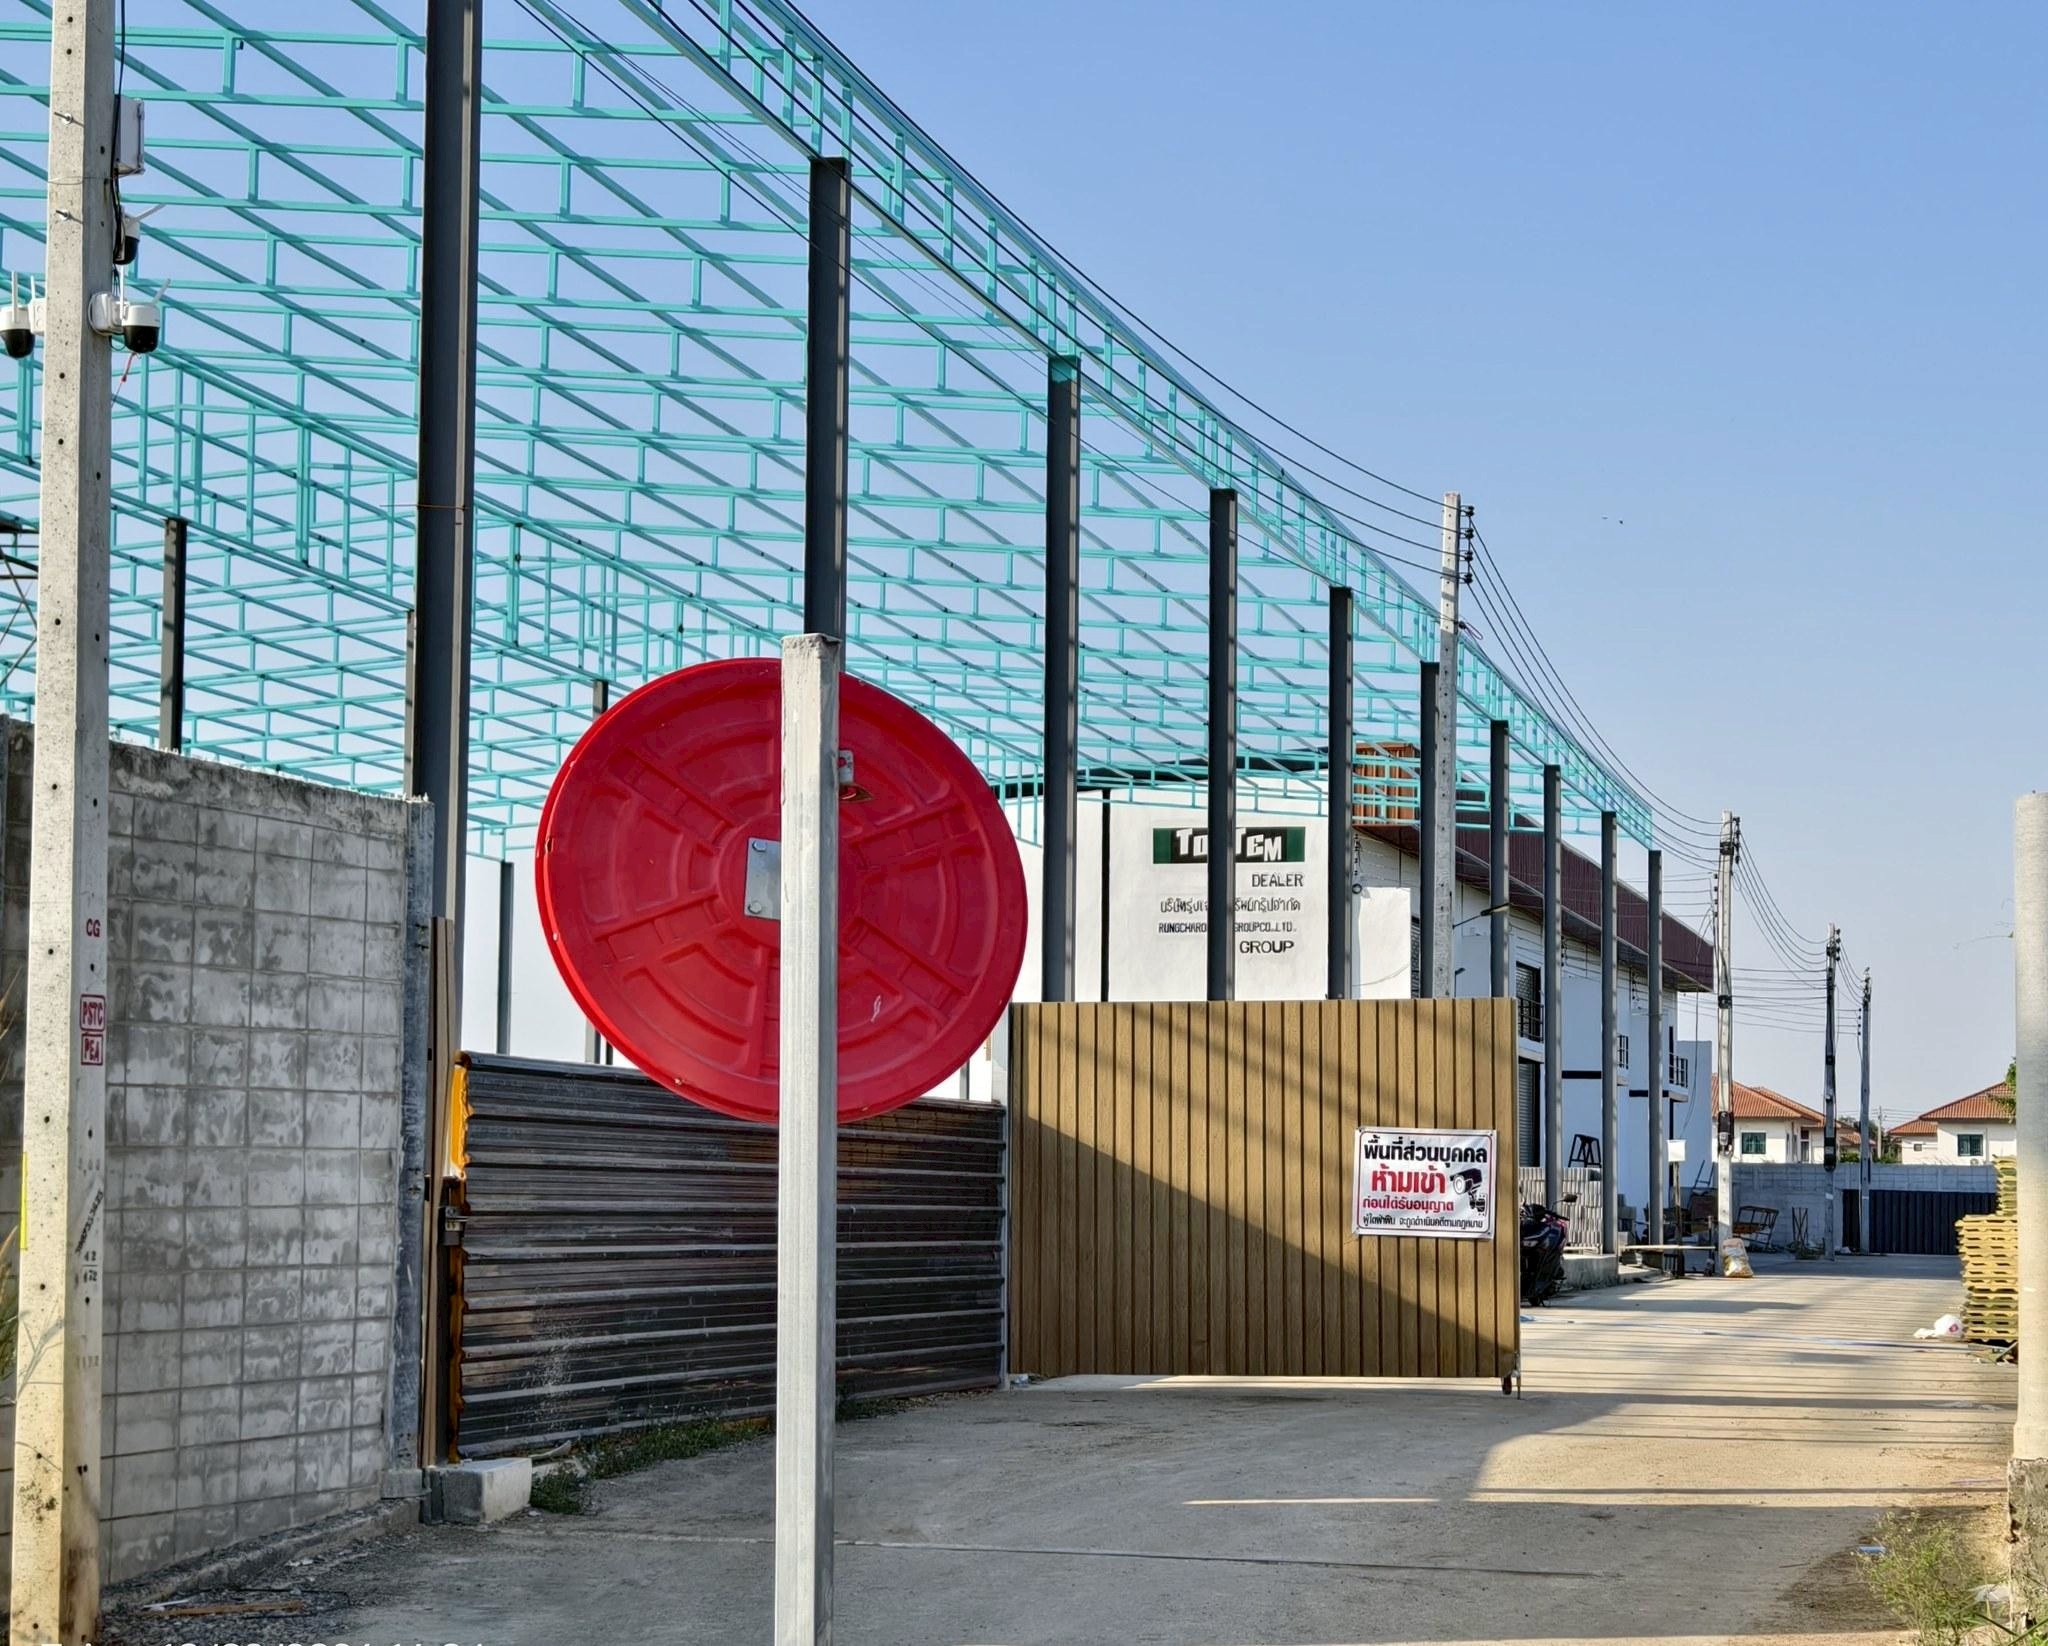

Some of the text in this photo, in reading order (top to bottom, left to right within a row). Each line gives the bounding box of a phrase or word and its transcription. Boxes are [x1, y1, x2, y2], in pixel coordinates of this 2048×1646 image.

[1176, 828, 1282, 861] TOTEM
[1252, 873, 1303, 887] DEALER
[86, 918, 100, 937] CG
[1239, 940, 1294, 954] GROUP
[83, 1001, 103, 1026] PSTC
[84, 1038, 100, 1062] PEA
[1364, 1134, 1488, 1168] พื้นที่ส่วนบุคคล
[1371, 1163, 1446, 1194] ห้ามเข้า
[1362, 1194, 1454, 1213] ก่อนได้รับอนุญาต
